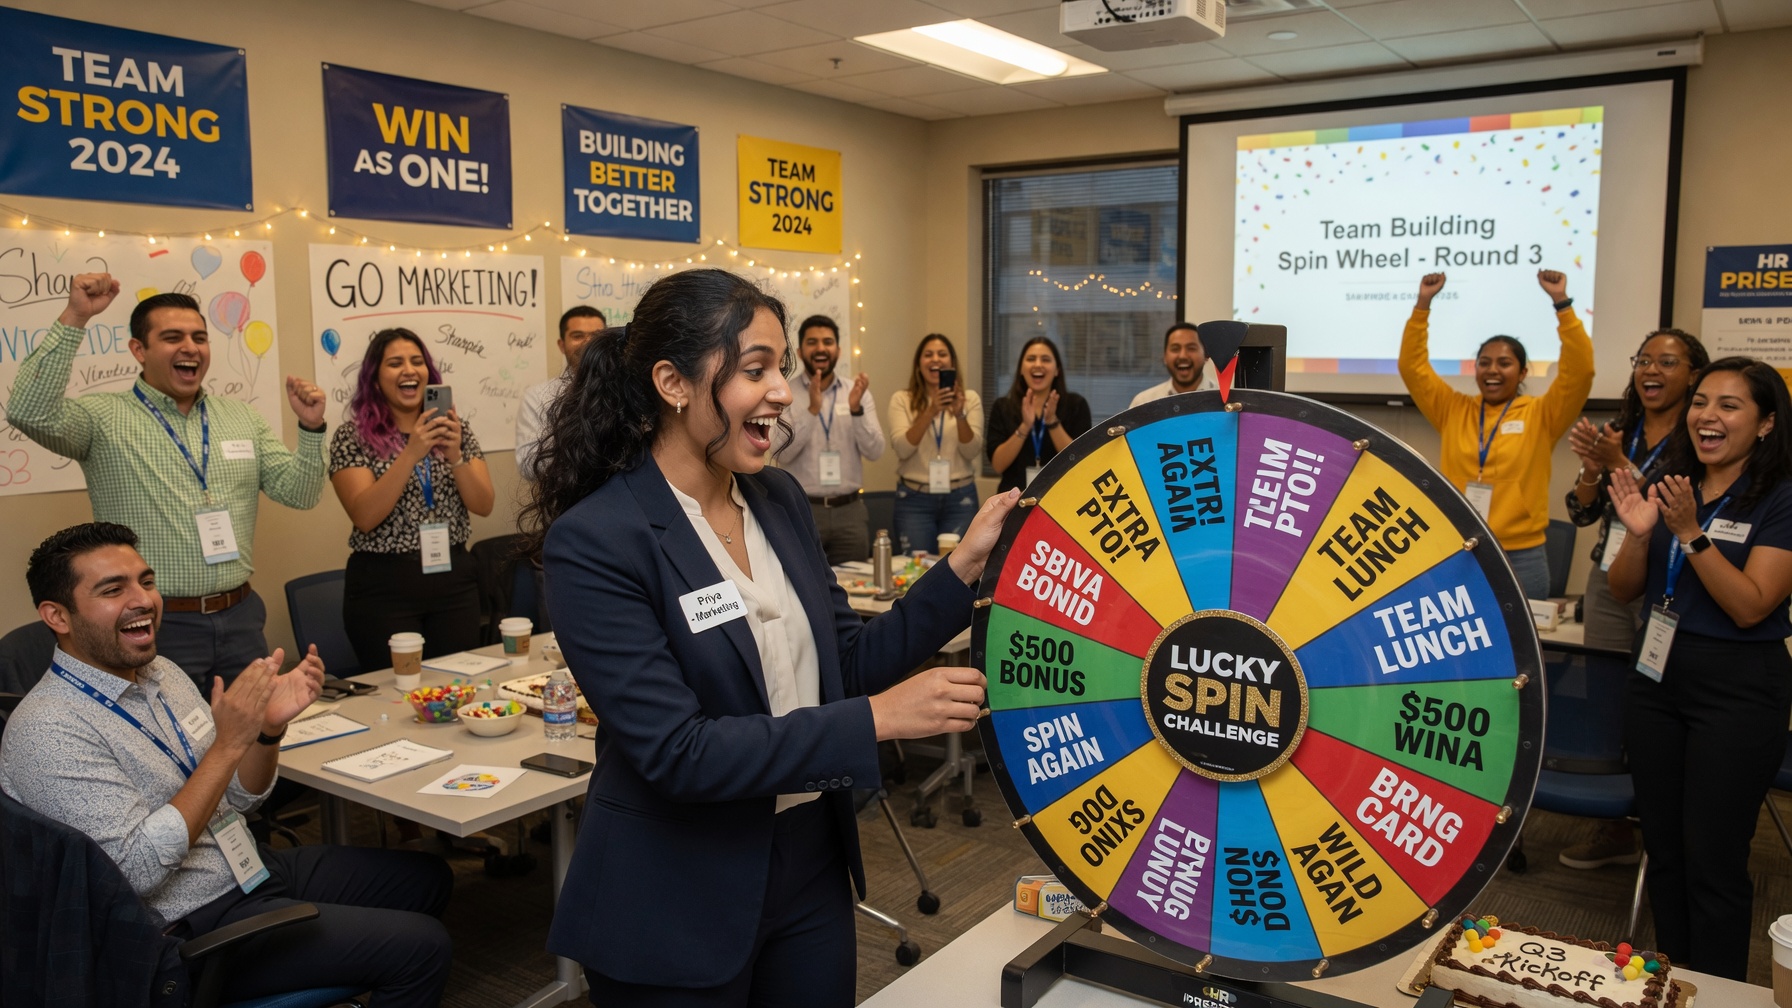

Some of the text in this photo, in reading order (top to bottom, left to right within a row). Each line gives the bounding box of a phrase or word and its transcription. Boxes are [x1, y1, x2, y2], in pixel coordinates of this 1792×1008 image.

[52, 46, 184, 97] TEAM
[17, 85, 220, 143] STRONG
[372, 102, 470, 154] WIN
[68, 137, 180, 179] 2024
[353, 148, 489, 194] AS ONE!
[579, 130, 685, 167] BUILDING
[767, 158, 815, 183] TEAM
[590, 160, 676, 193] BETTER
[749, 181, 833, 212] STRONG
[573, 188, 693, 222] TOGETHER
[772, 213, 812, 235] 2024
[1320, 214, 1496, 240] Team Building
[326, 259, 384, 308] GO
[399, 266, 537, 307] MARKETING!
[1278, 250, 1328, 275] Spin
[1337, 248, 1409, 269] Wheel
[1435, 244, 1519, 267] Round
[1529, 244, 1543, 266] 3
[1757, 253, 1789, 269] HR
[1091, 469, 1161, 562] EXTRA
[1274, 447, 1324, 537] PTO!!
[1076, 497, 1131, 564] PTO!
[1317, 486, 1401, 567] TEAM
[1030, 540, 1103, 602] SBIVA
[1332, 507, 1430, 602] LUNCH
[697, 592, 722, 605] Priya
[1016, 564, 1095, 626] BONID
[1373, 585, 1475, 638] TEAM
[1009, 630, 1074, 666] $500
[1171, 644, 1281, 684] LUCKY
[1374, 617, 1492, 675] LUNCH
[1000, 660, 1085, 696] BONUS
[1162, 673, 1282, 728] SPIN
[1023, 712, 1084, 752] SPIN
[1163, 713, 1280, 748] CHALLENGE
[1400, 690, 1490, 737] $500
[1027, 737, 1104, 785] AGAIN
[1394, 722, 1484, 772] WINA
[1068, 784, 1119, 834] DOG
[1369, 767, 1463, 843] BRNG
[1356, 796, 1444, 867] CARD
[1291, 844, 1364, 925] AGAN
[1318, 822, 1383, 900] WILD
[1519, 941, 1568, 963] Q3
